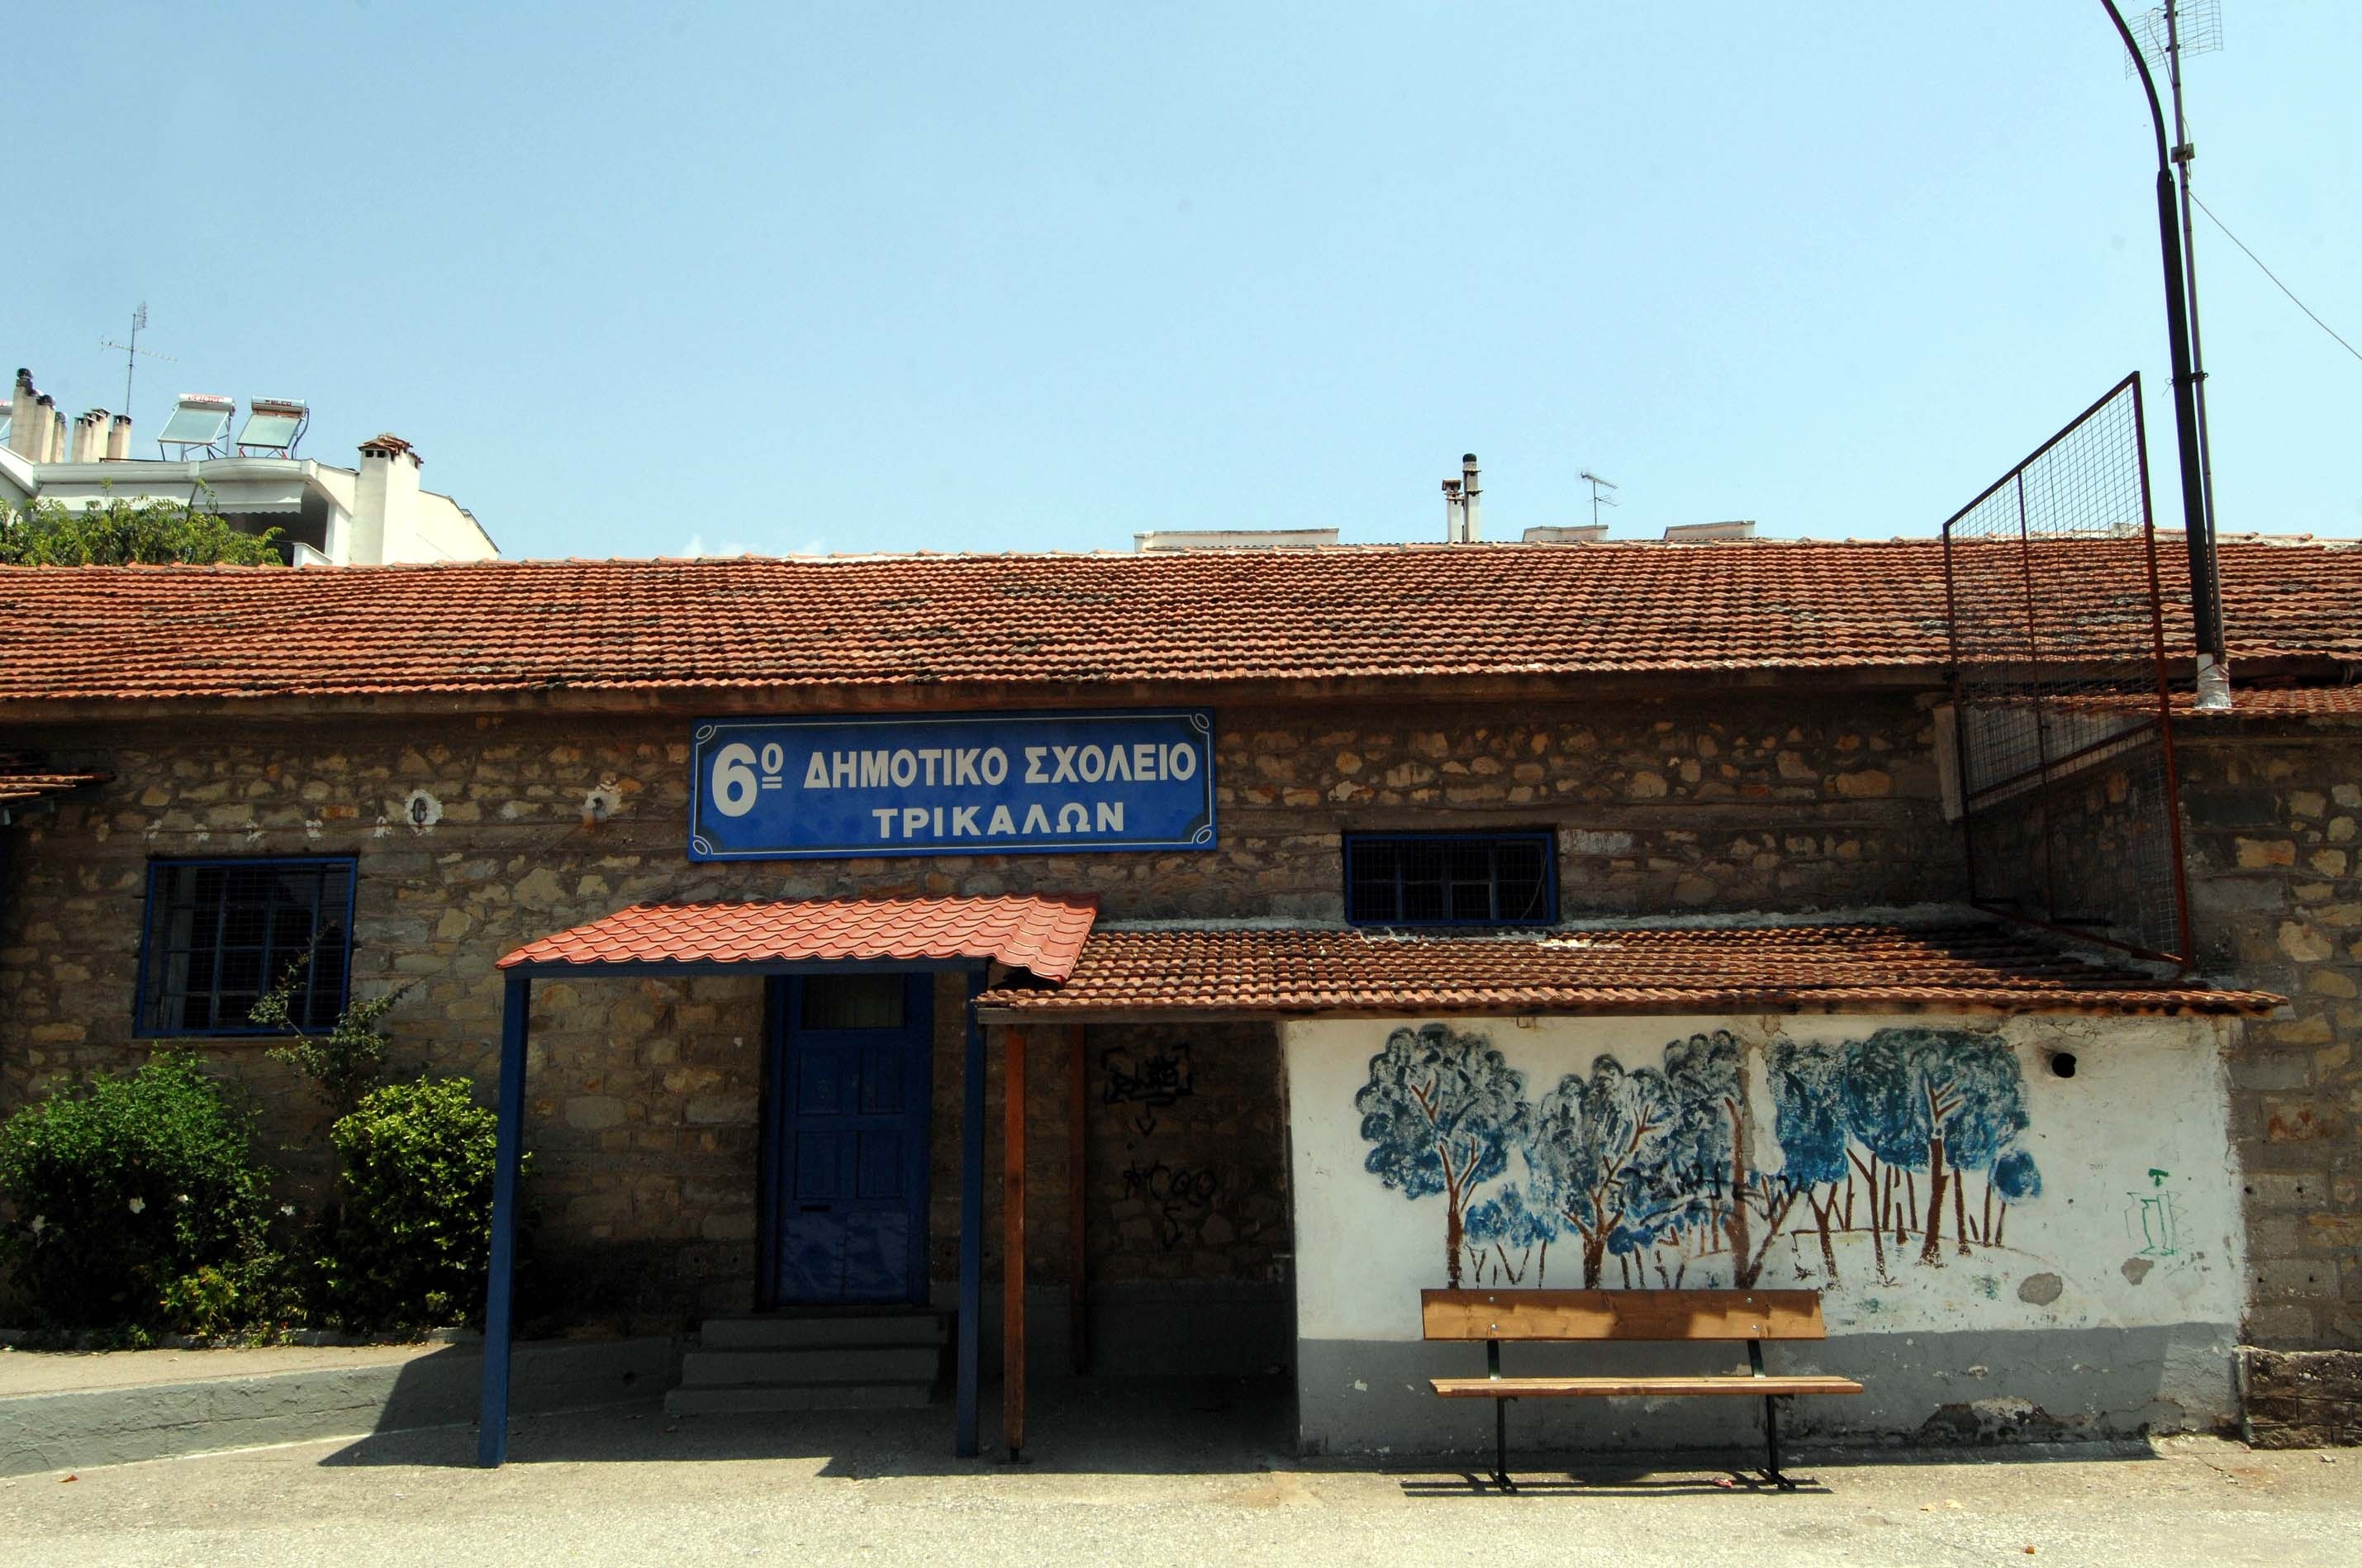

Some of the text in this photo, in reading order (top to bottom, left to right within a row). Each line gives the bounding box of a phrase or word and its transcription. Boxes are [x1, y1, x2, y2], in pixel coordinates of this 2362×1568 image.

[803, 747, 1008, 789] ΔΗΜΟΤΙΚΟ
[1024, 743, 1196, 784] ΣΧΟΛΕΙΟ
[872, 801, 1124, 839] ΤΡΙΚΑΛΩΝ
